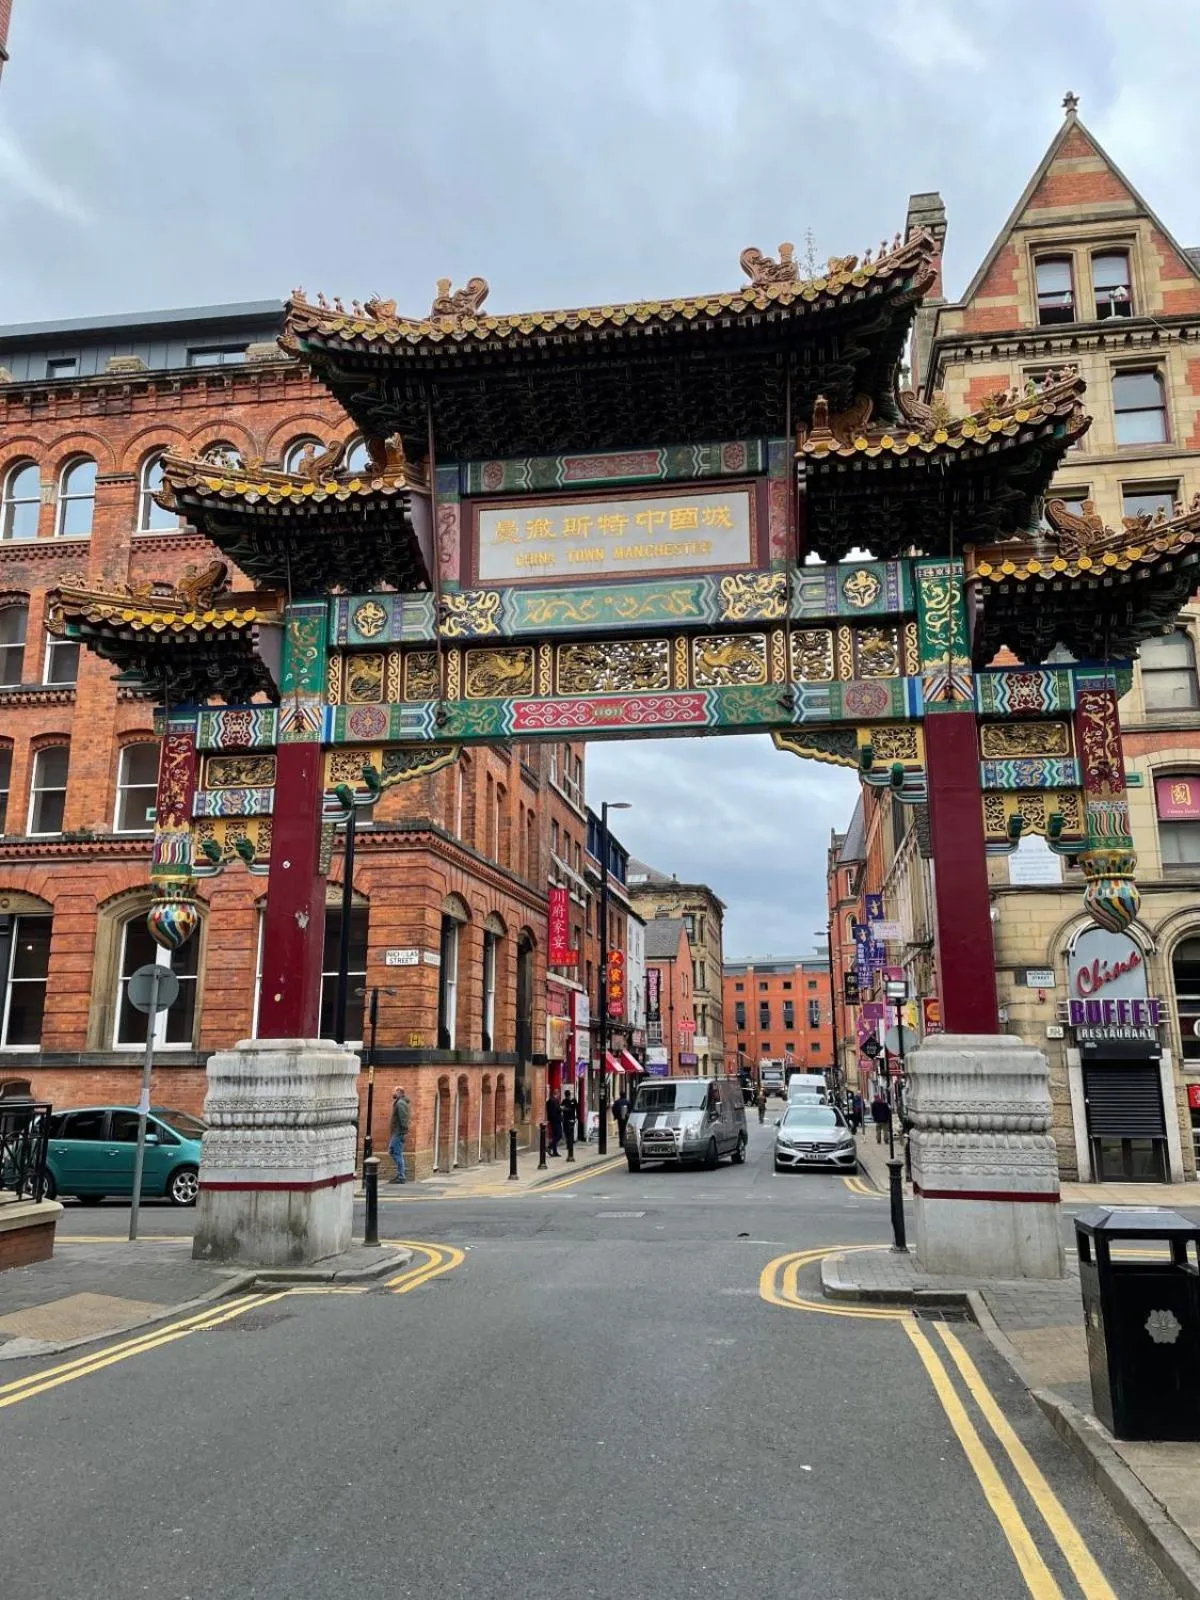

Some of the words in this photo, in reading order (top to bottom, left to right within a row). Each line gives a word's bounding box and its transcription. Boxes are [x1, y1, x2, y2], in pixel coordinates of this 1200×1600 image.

[515, 551, 555, 567] CHINA
[567, 547, 604, 563] TOWN
[614, 541, 712, 560] MANCHESTER
[1077, 950, 1142, 997] China
[1069, 998, 1160, 1027] BUFFET
[1081, 1027, 1153, 1039] RESTAURANT
